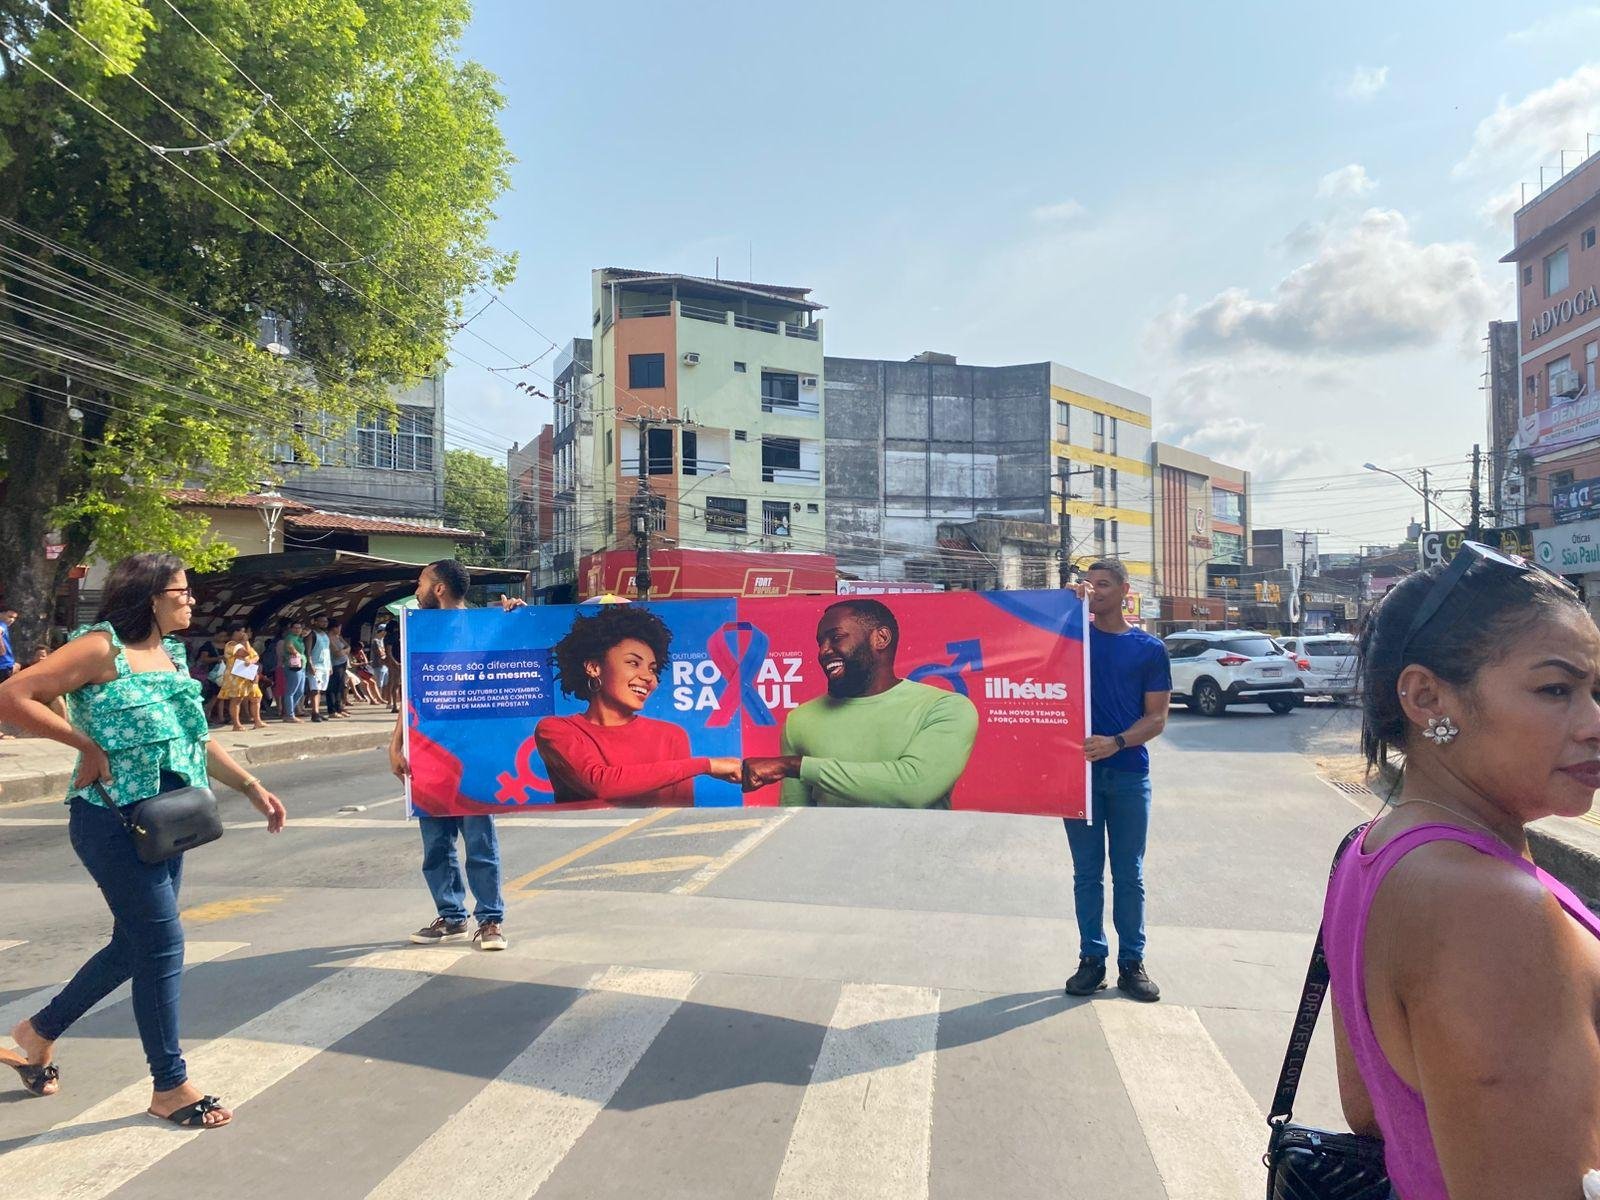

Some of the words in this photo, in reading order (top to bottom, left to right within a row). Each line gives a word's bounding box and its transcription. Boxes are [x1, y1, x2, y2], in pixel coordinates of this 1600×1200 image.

[1530, 285, 1599, 340] ADVOGA
[1562, 547, 1578, 566] São
[755, 577, 773, 587] FORT
[422, 663, 434, 672] As
[436, 663, 462, 672] cores
[466, 662, 484, 671] são
[487, 660, 541, 671] diferentes,
[672, 652, 708, 660] OUTUBRO
[422, 674, 445, 682] mas
[445, 674, 453, 682] a
[455, 672, 475, 682] luta
[478, 671, 486, 680] é
[496, 670, 541, 680] mesma.
[672, 660, 721, 686] RO
[756, 657, 803, 683] AZ
[467, 688, 498, 696] OUTUBRO
[673, 686, 721, 711] SA
[758, 684, 800, 709] UL
[984, 677, 1067, 700] ilhéus
[435, 703, 460, 711] CÂNCER
[1292, 982, 1324, 1052] FOREVER
[1281, 1057, 1302, 1096] LOVE
